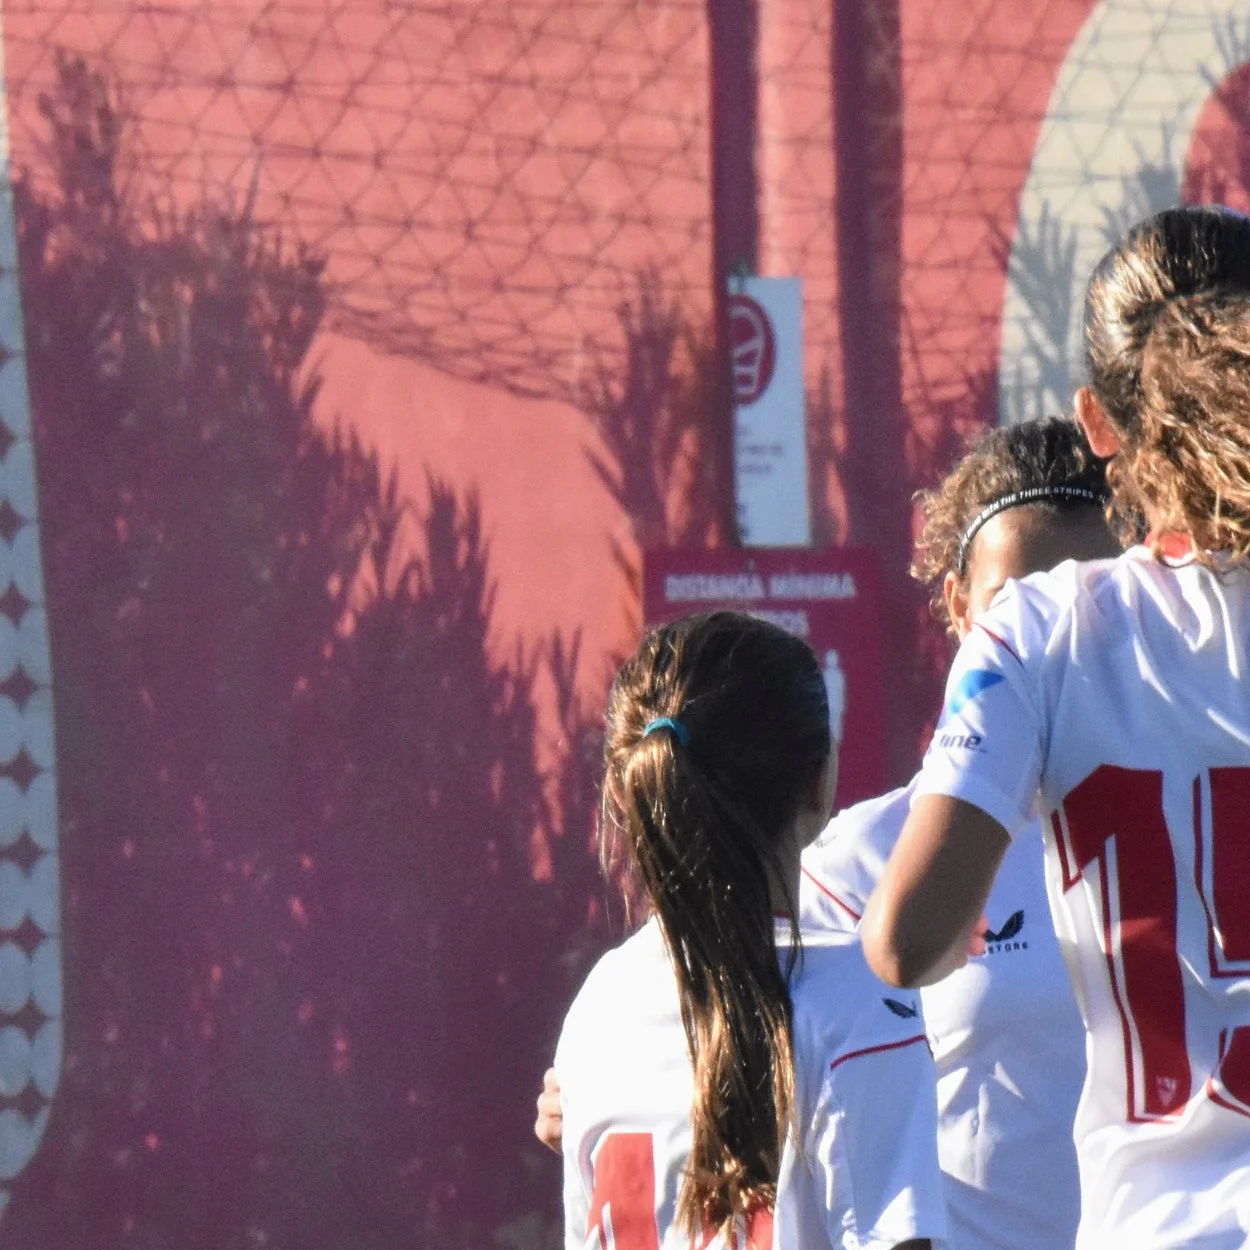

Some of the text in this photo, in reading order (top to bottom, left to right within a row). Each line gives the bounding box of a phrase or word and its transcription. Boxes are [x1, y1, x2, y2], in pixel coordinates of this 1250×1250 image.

[1019, 486, 1051, 499] THREE
[1053, 486, 1094, 499] STRIPES
[983, 941, 1029, 955] STORE
